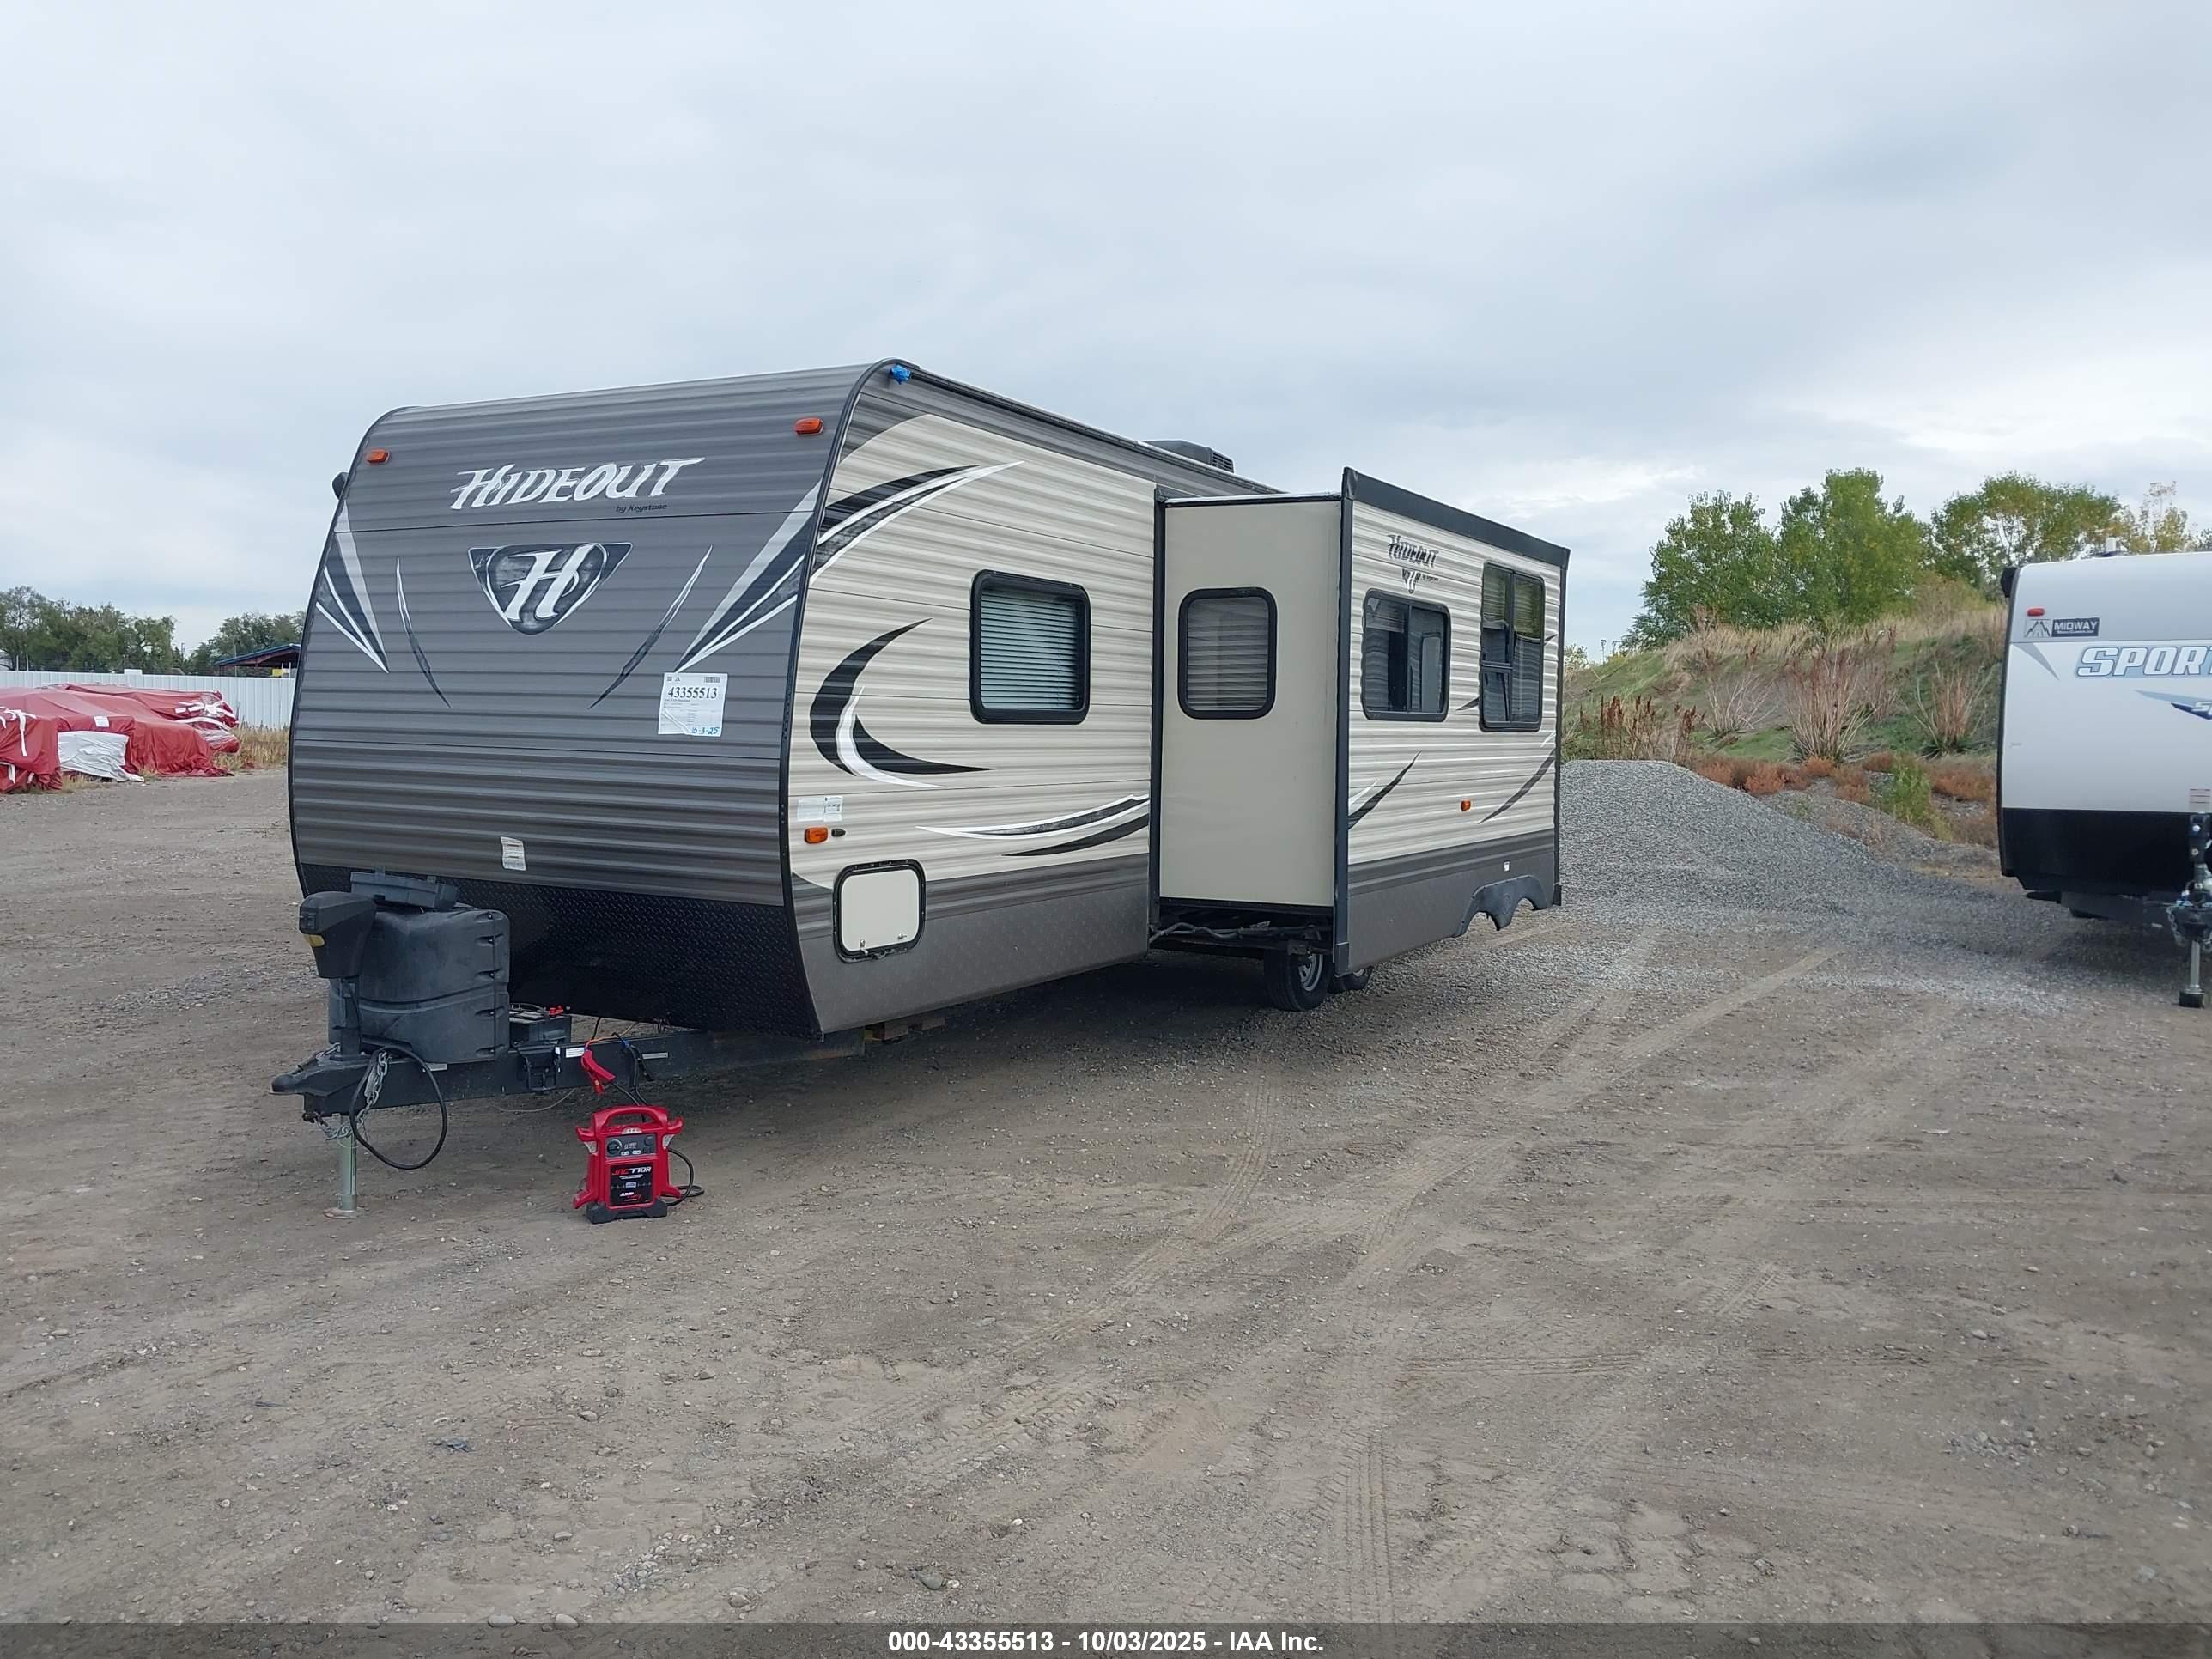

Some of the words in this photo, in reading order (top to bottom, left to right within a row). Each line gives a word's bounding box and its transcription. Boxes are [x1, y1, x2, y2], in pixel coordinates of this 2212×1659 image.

[450, 457, 705, 510] HIDEOUT
[1388, 534, 1439, 568] HIDEOUT
[2054, 622, 2098, 630] MIDWAY
[2077, 646, 2212, 677] SPOR
[668, 687, 718, 699] 43355513
